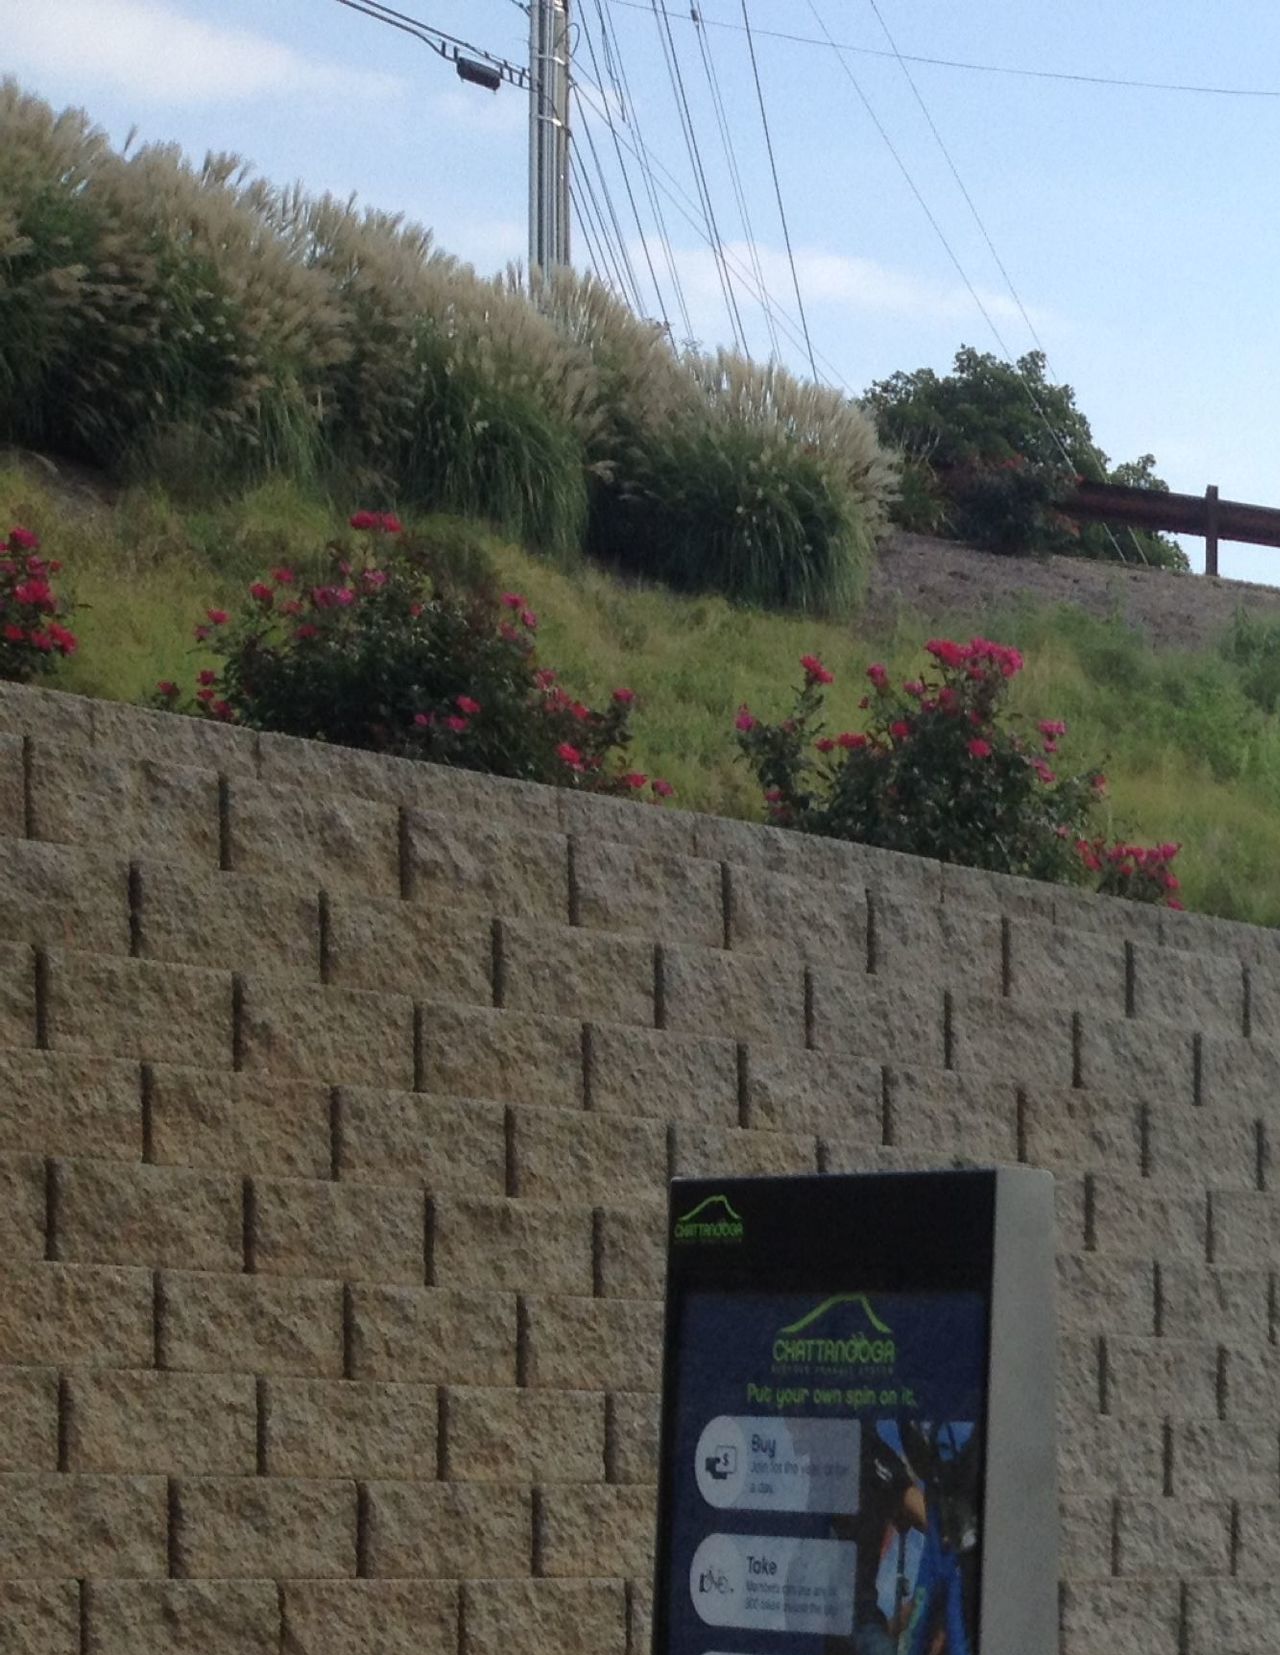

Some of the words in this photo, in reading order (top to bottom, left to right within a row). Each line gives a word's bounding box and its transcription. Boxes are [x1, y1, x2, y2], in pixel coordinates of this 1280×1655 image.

[772, 1337, 896, 1362] CHATTANOOGA
[746, 1382, 771, 1403] Put
[776, 1388, 809, 1409] your
[813, 1388, 841, 1404] own
[846, 1386, 876, 1409] spin
[879, 1388, 897, 1405] on
[751, 1434, 777, 1458] Buy
[747, 1555, 778, 1577] Take
